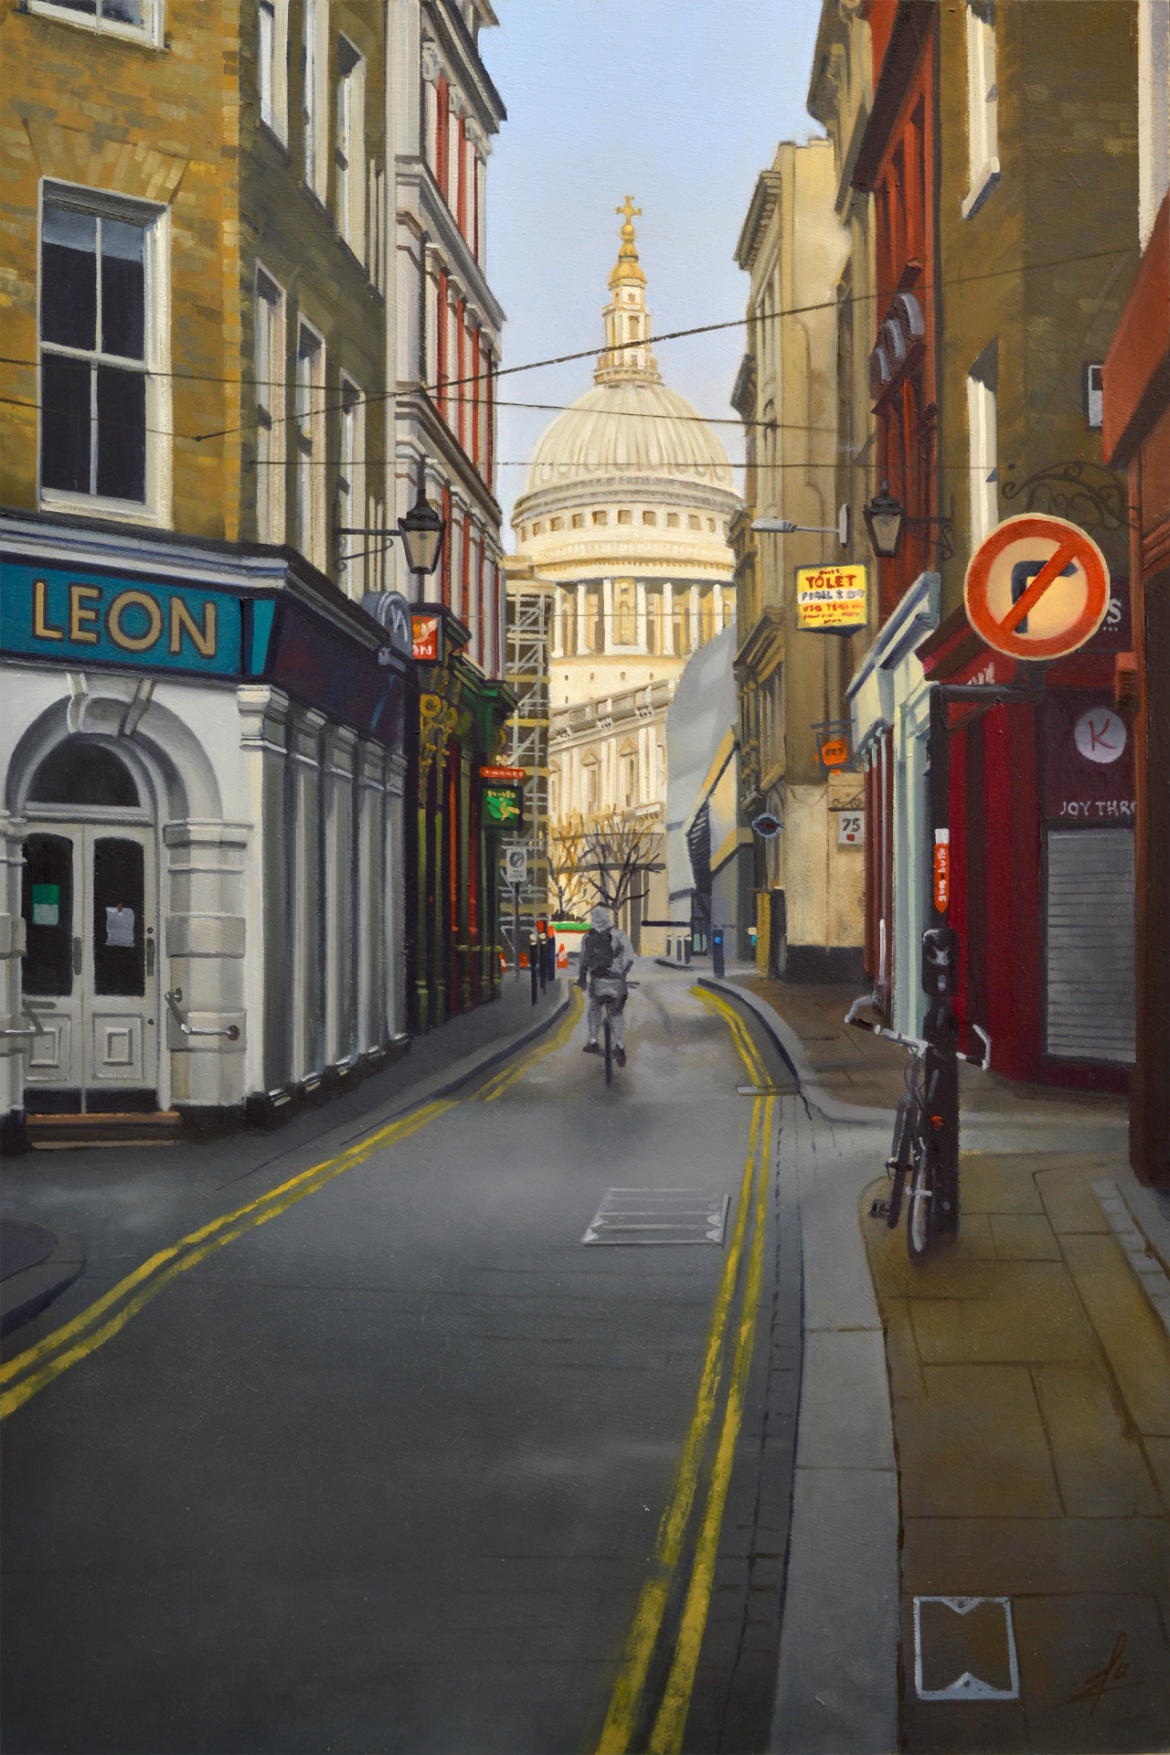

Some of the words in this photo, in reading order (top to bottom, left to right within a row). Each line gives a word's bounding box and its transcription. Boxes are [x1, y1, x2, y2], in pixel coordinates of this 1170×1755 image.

[32, 578, 218, 659] LEON
[1089, 718, 1118, 752] K
[1060, 801, 1092, 816] JOY
[842, 817, 861, 833] 75
